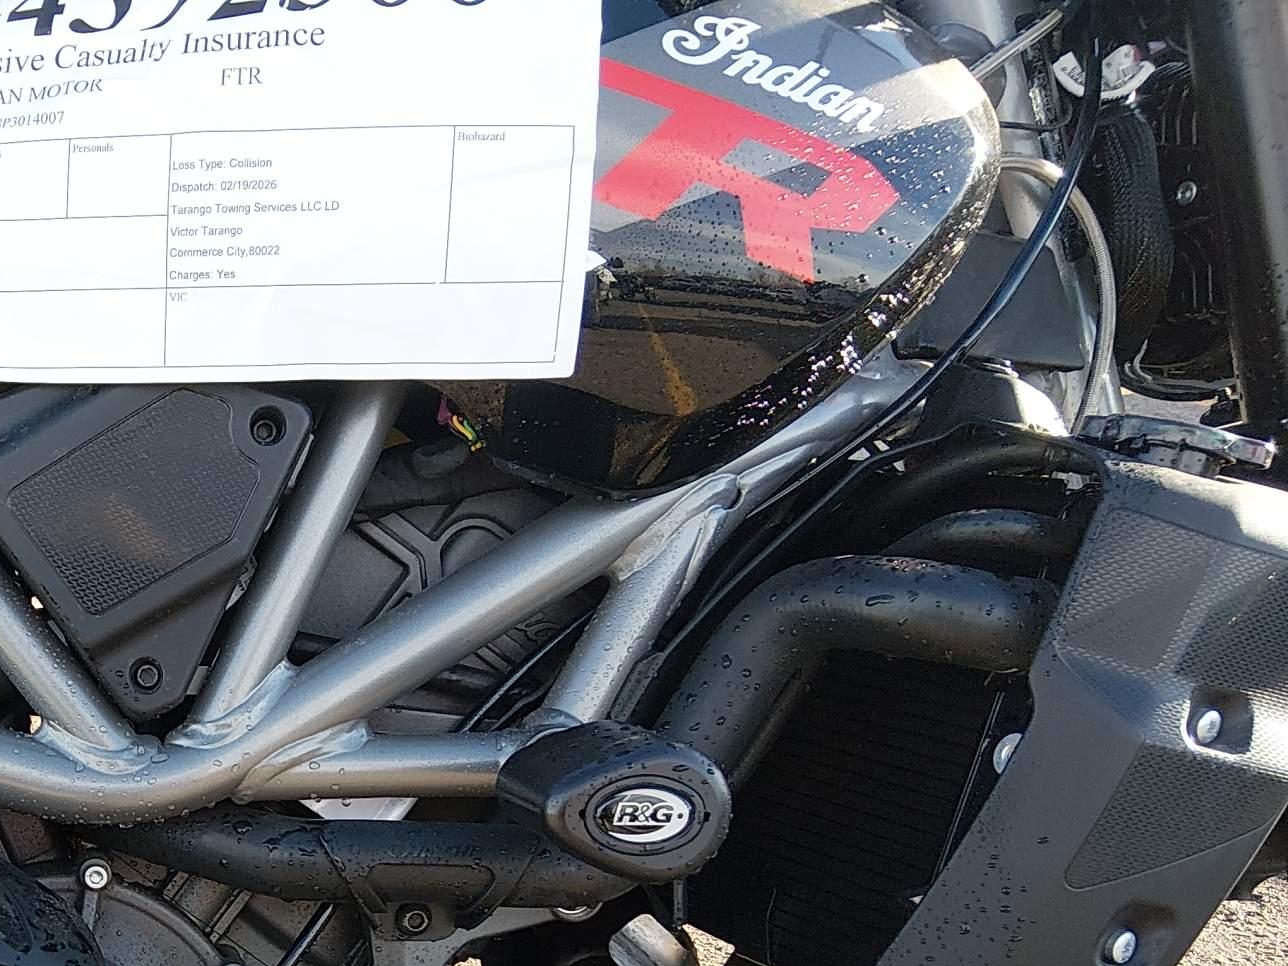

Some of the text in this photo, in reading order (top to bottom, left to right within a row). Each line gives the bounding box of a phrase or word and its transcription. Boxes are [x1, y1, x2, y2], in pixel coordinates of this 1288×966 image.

[55, 39, 171, 69] Casualty
[180, 27, 326, 55] Insurance
[662, 16, 884, 133] Indian
[28, 78, 103, 103] MOTOR
[220, 67, 263, 86] FTR
[457, 131, 506, 142] Biohazard
[73, 143, 114, 153] Personals
[172, 157, 272, 171] Loss Type: Collision
[171, 179, 277, 193] Dispatch: 02/19/2026
[171, 200, 340, 216] Tarango Towing Services LLC LD
[170, 226, 243, 238] Victor Tarango
[169, 245, 280, 259] Commerce City,80022
[169, 269, 236, 282] Charges: Yes
[617, 803, 674, 823] R&G
